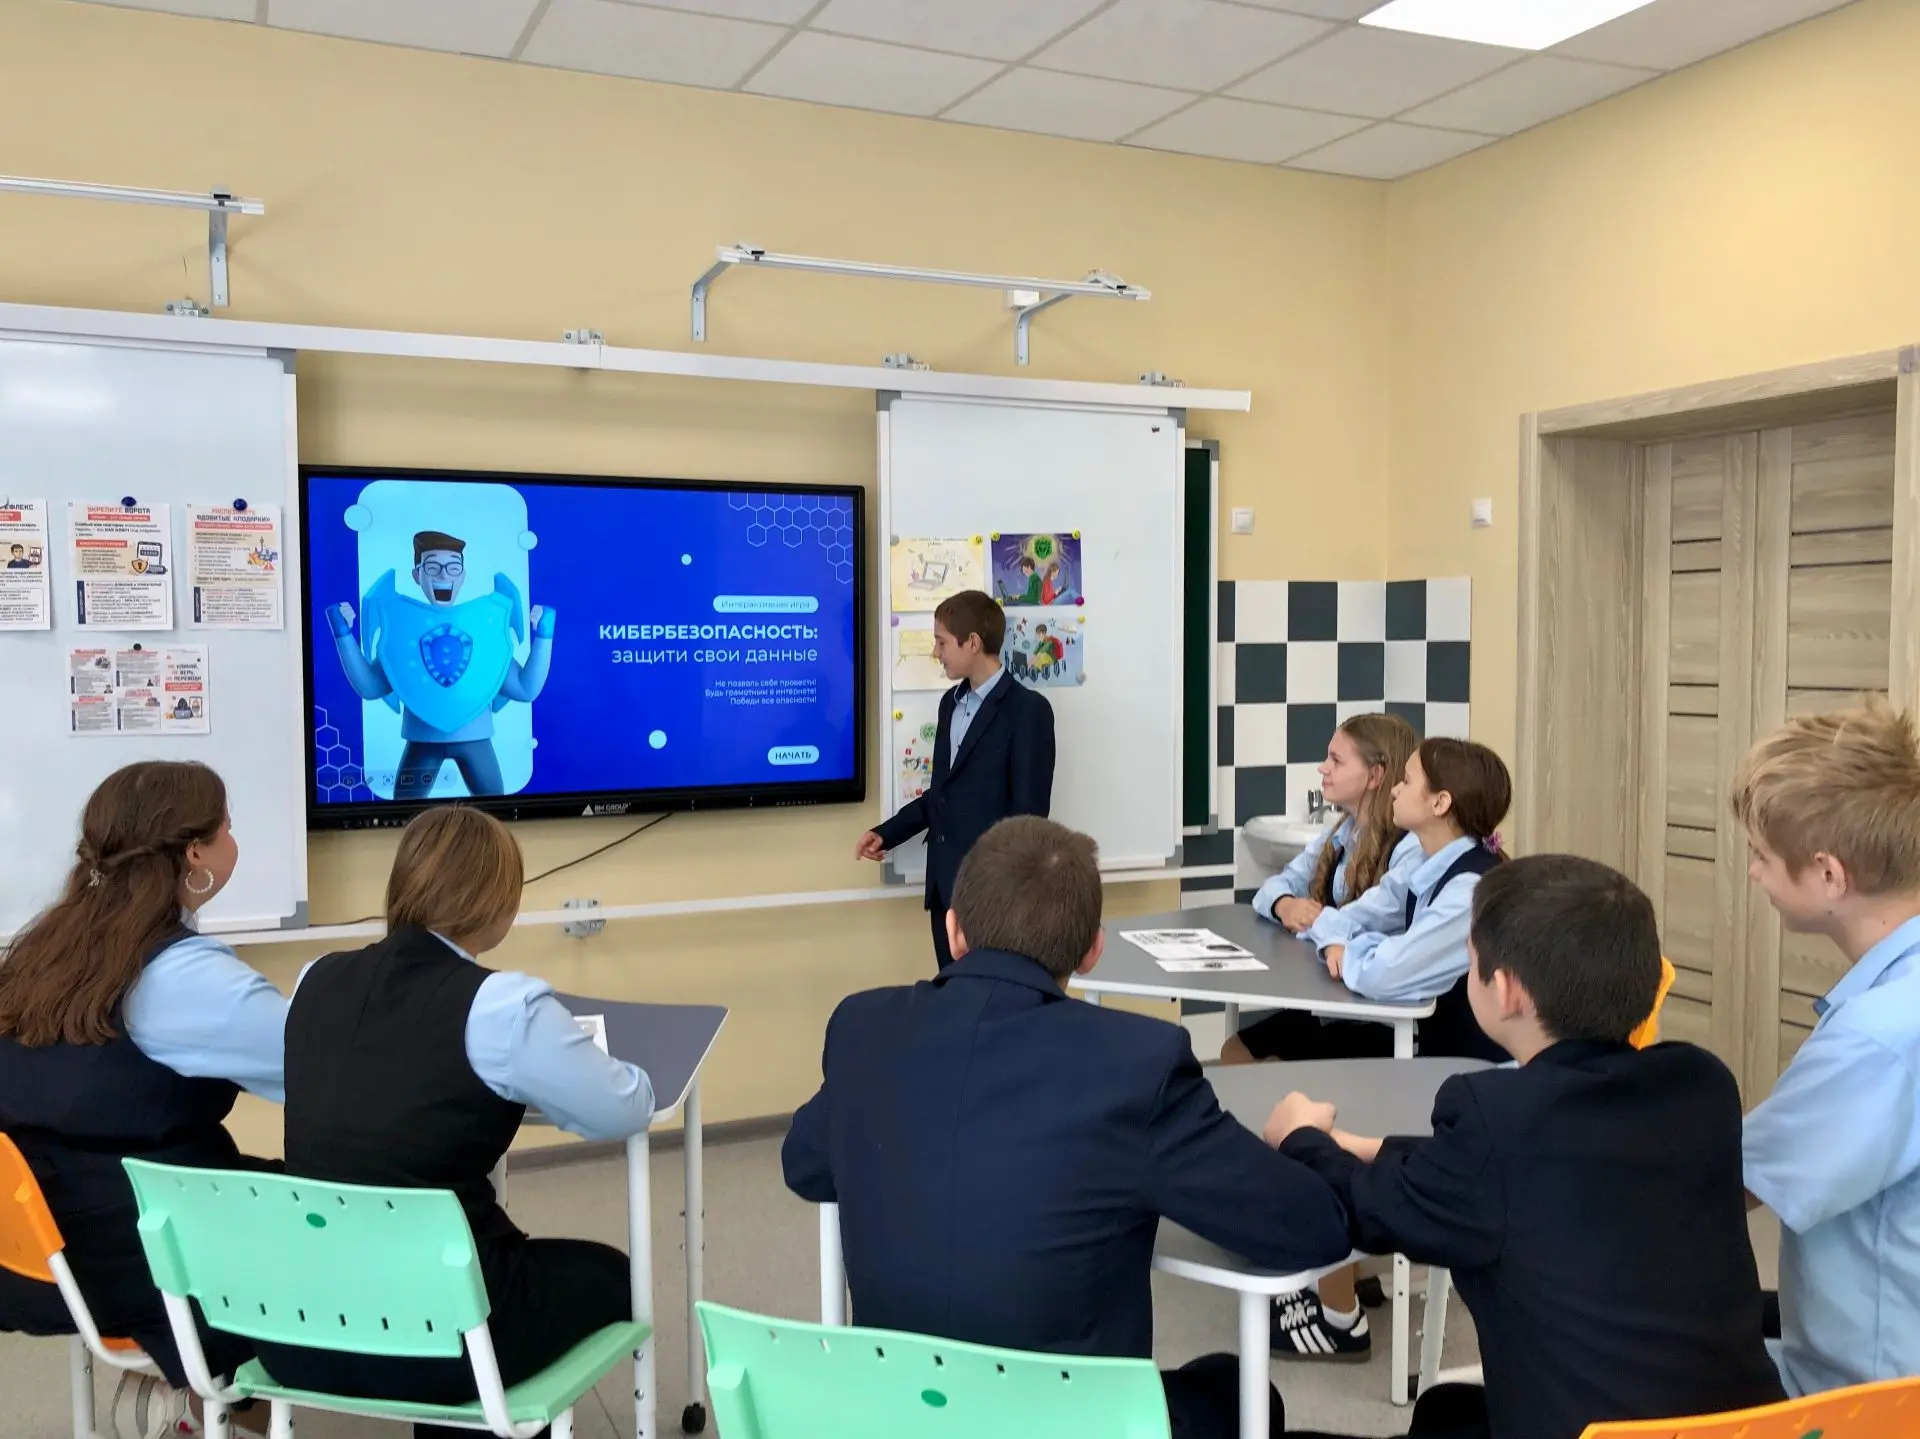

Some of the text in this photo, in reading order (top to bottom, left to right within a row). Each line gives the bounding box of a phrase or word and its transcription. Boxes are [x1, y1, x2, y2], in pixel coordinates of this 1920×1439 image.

[196, 514, 231, 522] ЯДОВИТЫЕ
[721, 600, 810, 610] Интерактивная игра
[599, 624, 818, 640] КИБЕРБЕЗОПАСНОСТЬ:
[612, 647, 818, 664] защити свои данные
[760, 679, 779, 687] себя
[780, 680, 817, 689] провести!
[705, 689, 724, 698] Будь
[725, 689, 768, 698] грамотным
[776, 688, 817, 696] интернете!
[730, 698, 760, 706] Победи
[776, 697, 817, 705] опасности!
[775, 751, 812, 760] НАЧАТЬ
